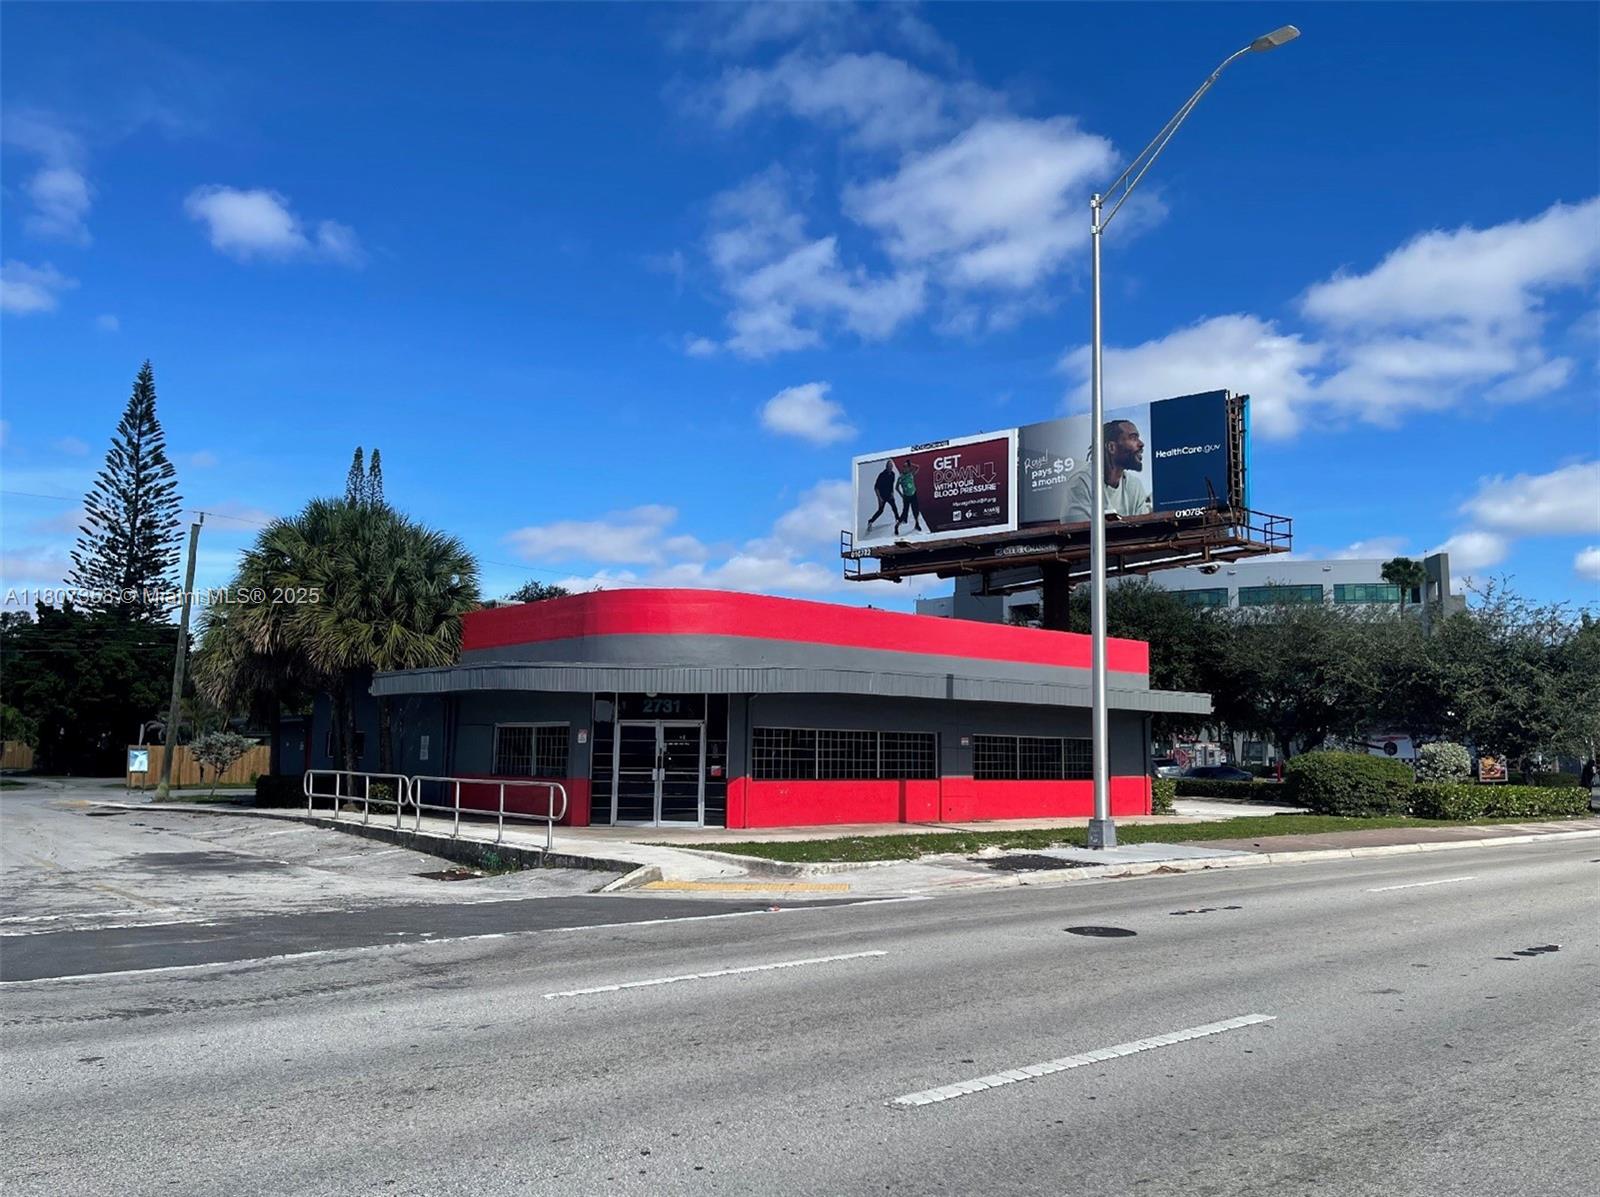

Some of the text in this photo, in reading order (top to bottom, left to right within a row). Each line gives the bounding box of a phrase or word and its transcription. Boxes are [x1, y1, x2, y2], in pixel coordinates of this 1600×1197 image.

[1155, 444, 1221, 458] HealthCare.gov
[933, 454, 961, 470] GET
[1031, 457, 1074, 480] pays $9
[933, 465, 980, 484] DOWN
[1031, 474, 1067, 488] a month
[933, 479, 974, 491] WITH YOUR
[933, 483, 996, 498] BLOOD PRESSURE
[642, 699, 681, 713] 2731
